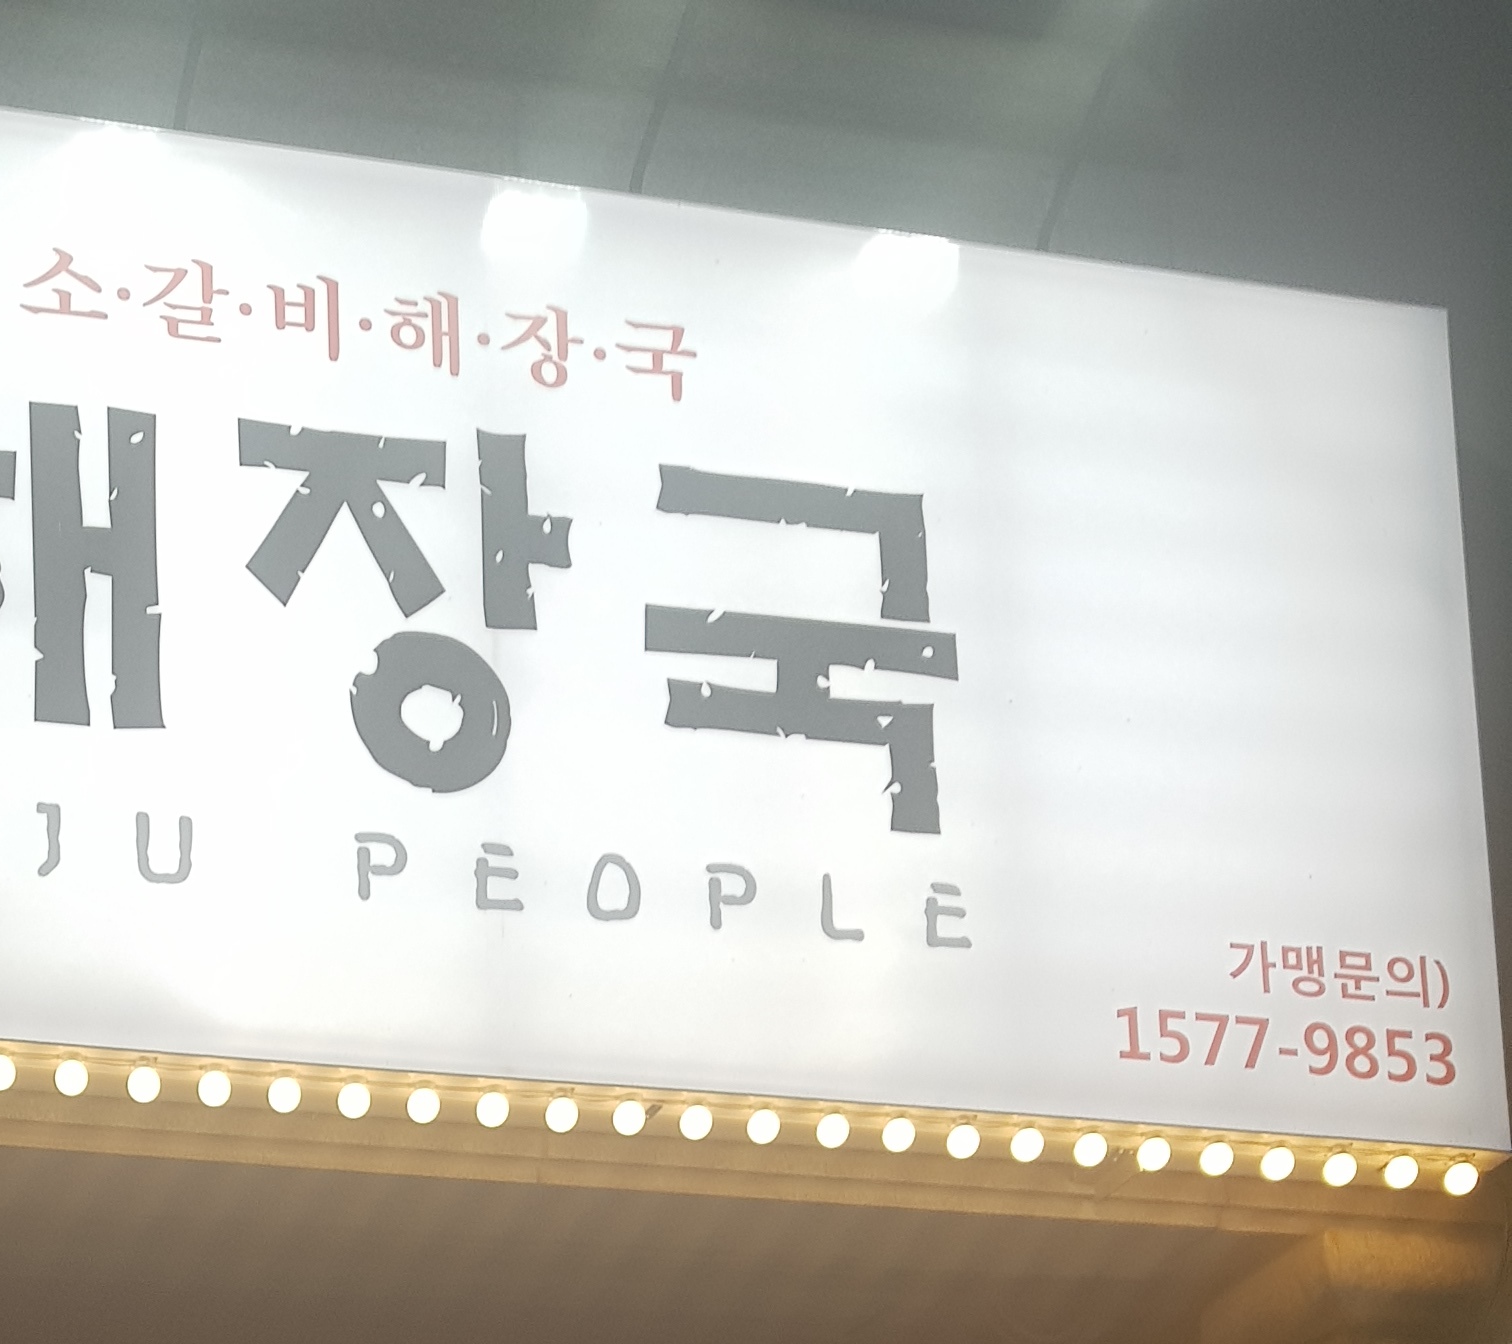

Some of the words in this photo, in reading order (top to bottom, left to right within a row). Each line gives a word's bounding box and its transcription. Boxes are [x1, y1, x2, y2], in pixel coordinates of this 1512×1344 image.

[353, 831, 974, 950] PEOPLE
[1228, 940, 1451, 1010] 가맹문의)
[1115, 1006, 1458, 1088] 1577-9853
